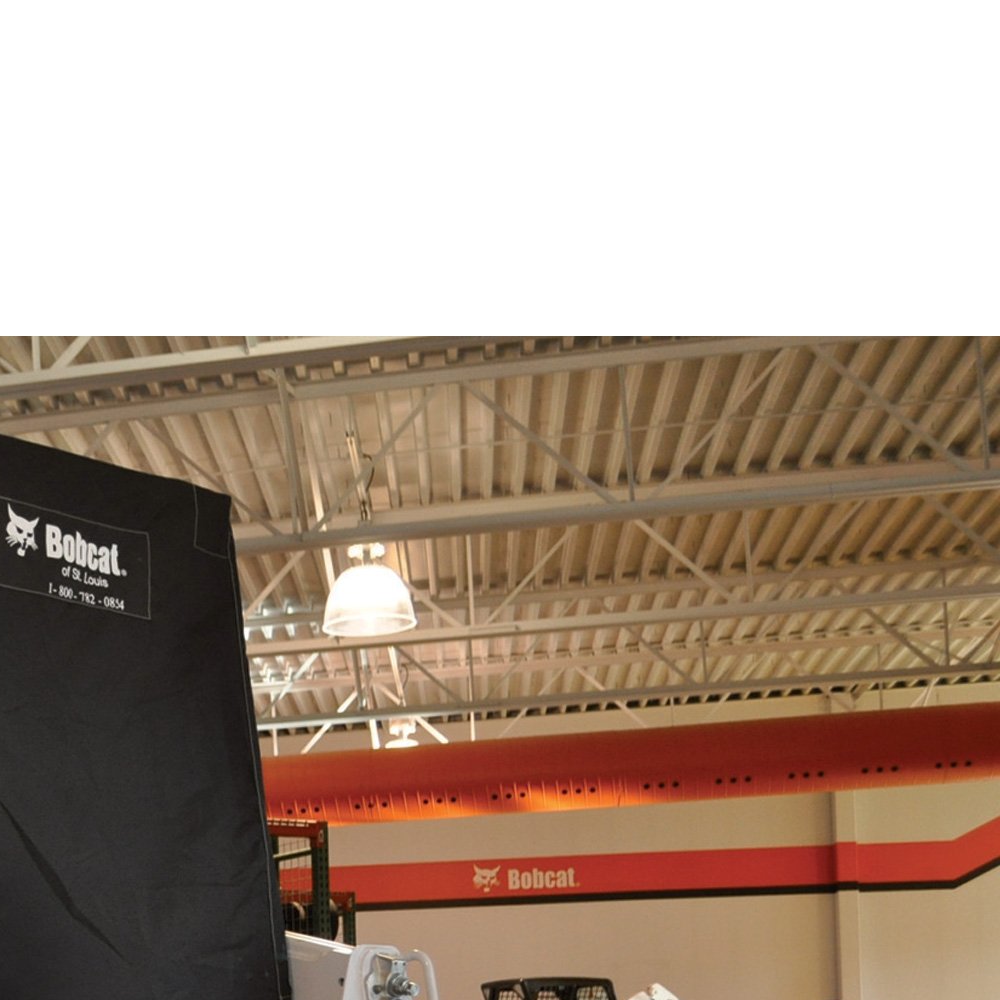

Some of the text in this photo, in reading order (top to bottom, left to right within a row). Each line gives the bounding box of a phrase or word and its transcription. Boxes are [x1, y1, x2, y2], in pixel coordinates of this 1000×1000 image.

[45, 523, 121, 577] Bobcat
[61, 566, 71, 577] of
[84, 571, 109, 588] Louis
[507, 867, 575, 891] Bobcat
